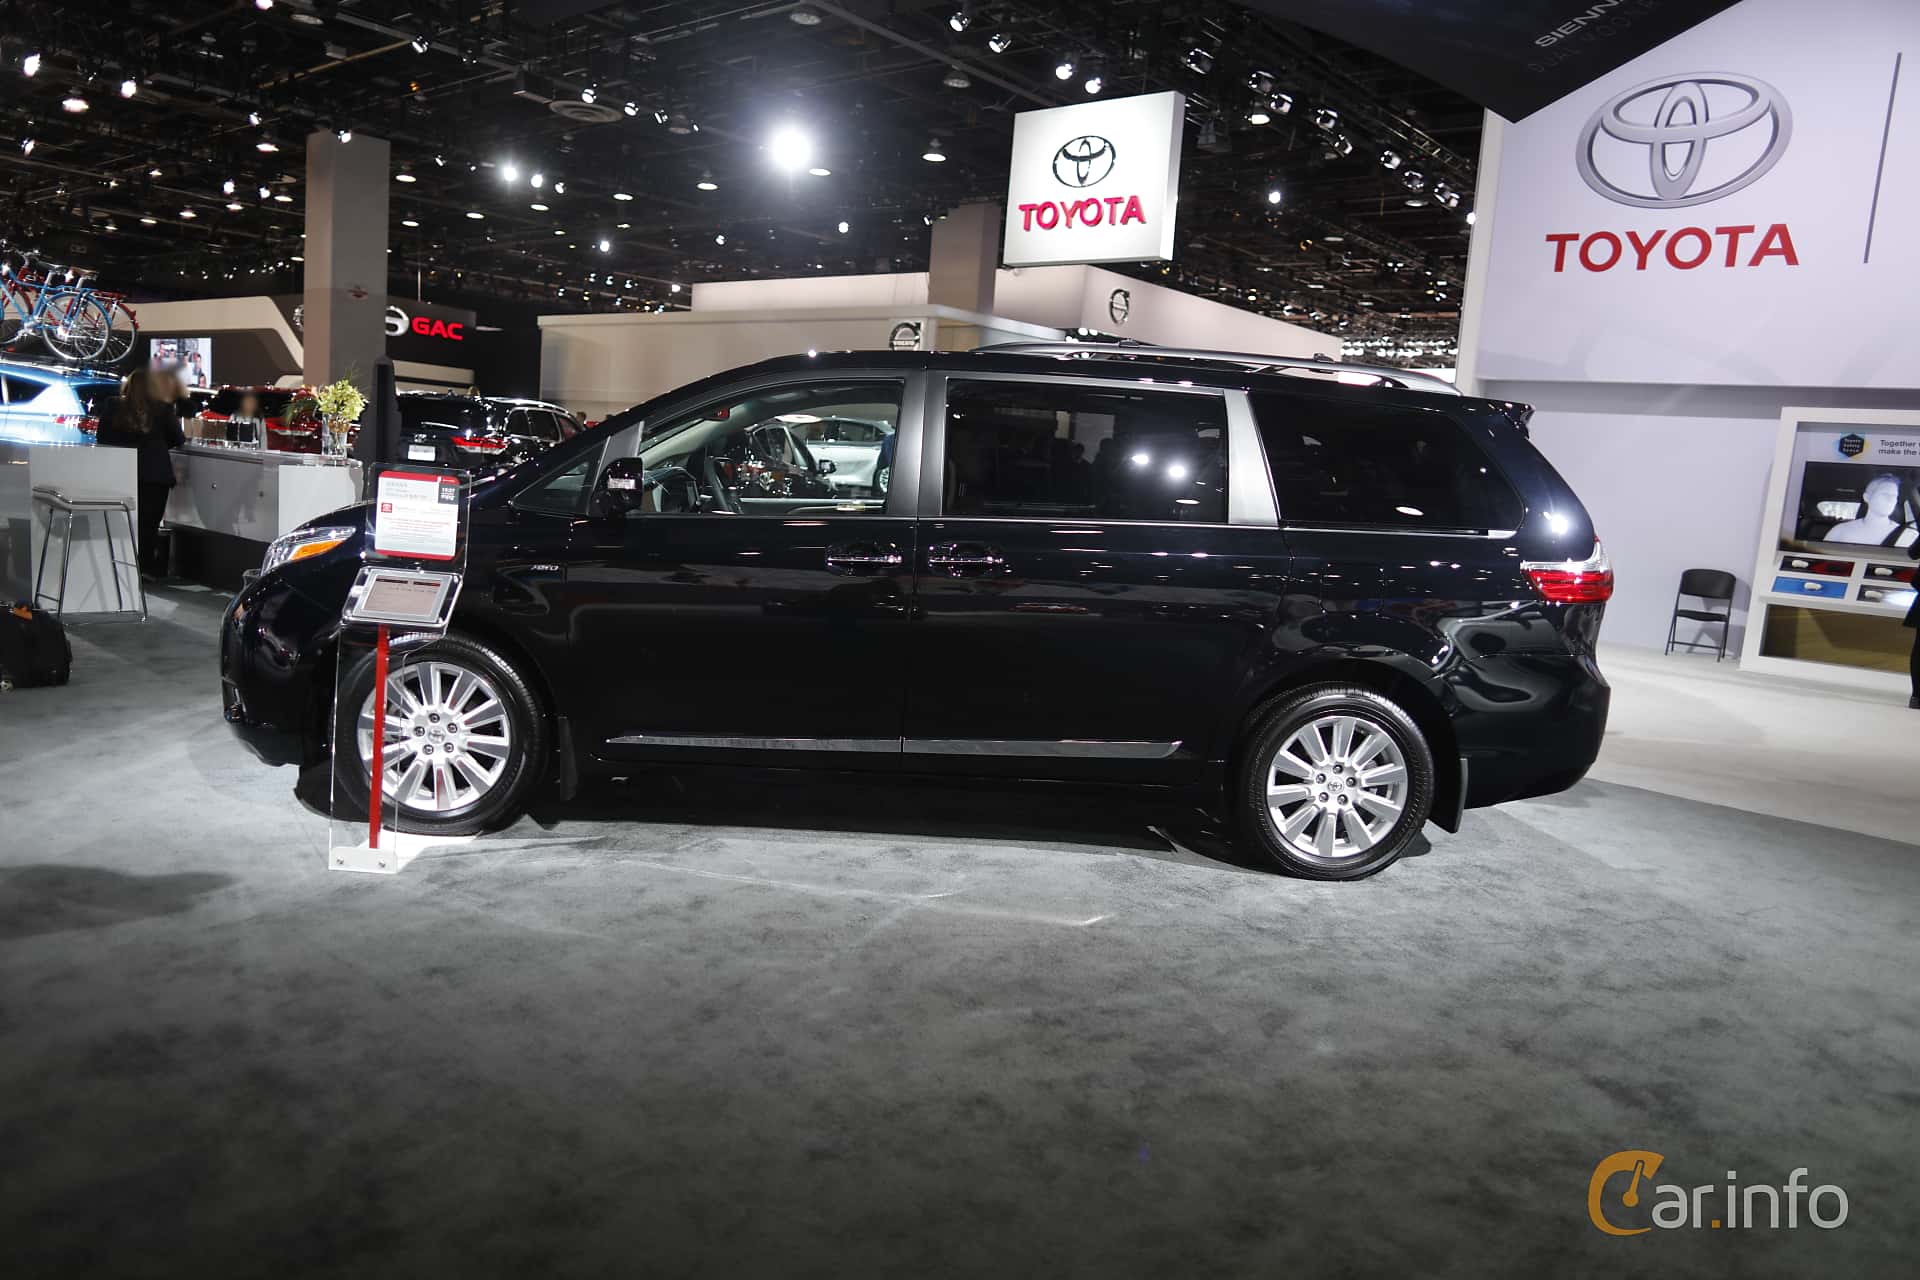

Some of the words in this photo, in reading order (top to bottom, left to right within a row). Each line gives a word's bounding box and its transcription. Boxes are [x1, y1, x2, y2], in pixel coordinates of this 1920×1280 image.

[1535, 0, 1624, 47] SIENN
[1018, 195, 1146, 232] TOYOTA
[1545, 223, 1799, 273] TOYOTA
[411, 316, 464, 341] GAC
